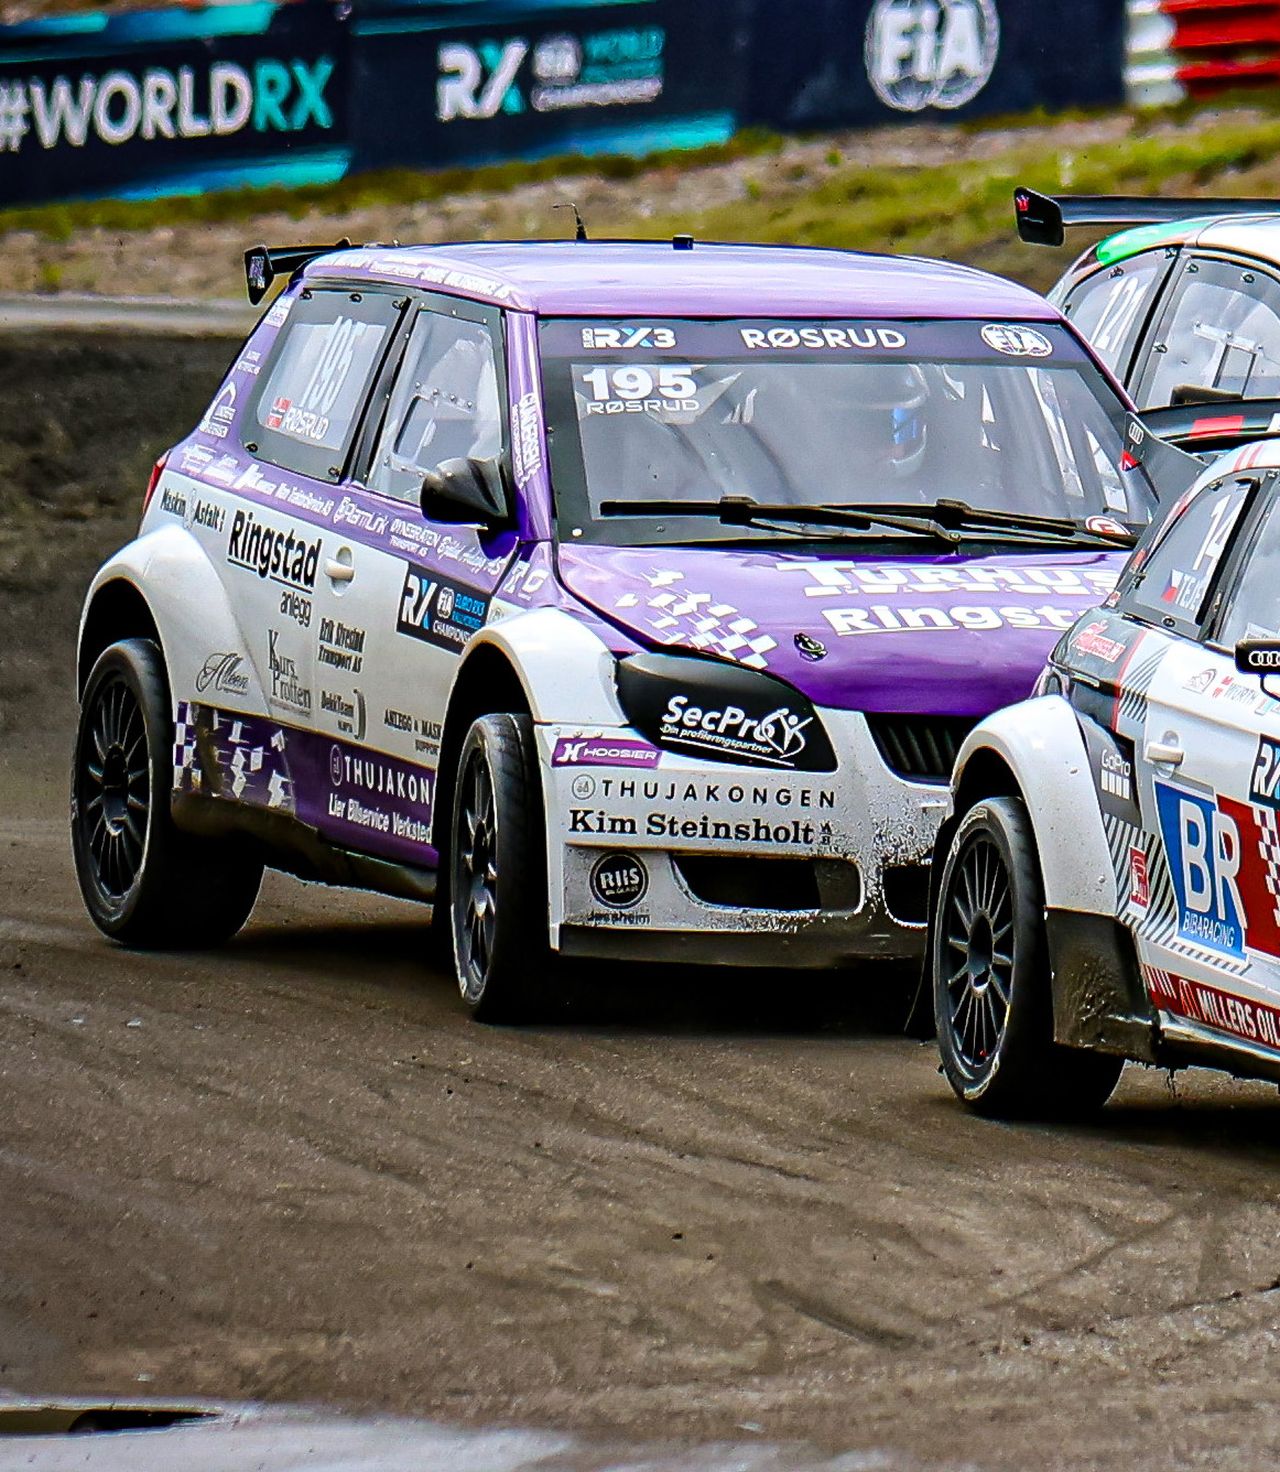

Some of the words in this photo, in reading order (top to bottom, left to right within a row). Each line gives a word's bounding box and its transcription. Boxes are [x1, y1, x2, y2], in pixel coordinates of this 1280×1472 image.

[876, 0, 990, 84] FIA
[0, 57, 334, 152] #WORLDRX
[594, 327, 676, 348] RX3
[740, 328, 906, 350] RØSRUD
[986, 328, 1049, 353] FIA
[583, 366, 697, 401] 195
[586, 400, 700, 415] RØSRUD
[228, 509, 323, 588] Ringstad
[822, 604, 1090, 632] Ringst
[661, 695, 776, 742] SecPro
[584, 748, 657, 761] HOOSIER
[602, 779, 835, 808] THUJAKONGEN
[568, 808, 637, 836] Kim
[646, 812, 815, 845] Steinsholt
[1180, 798, 1248, 929] BR
[1196, 987, 1257, 1039] MILLERS
